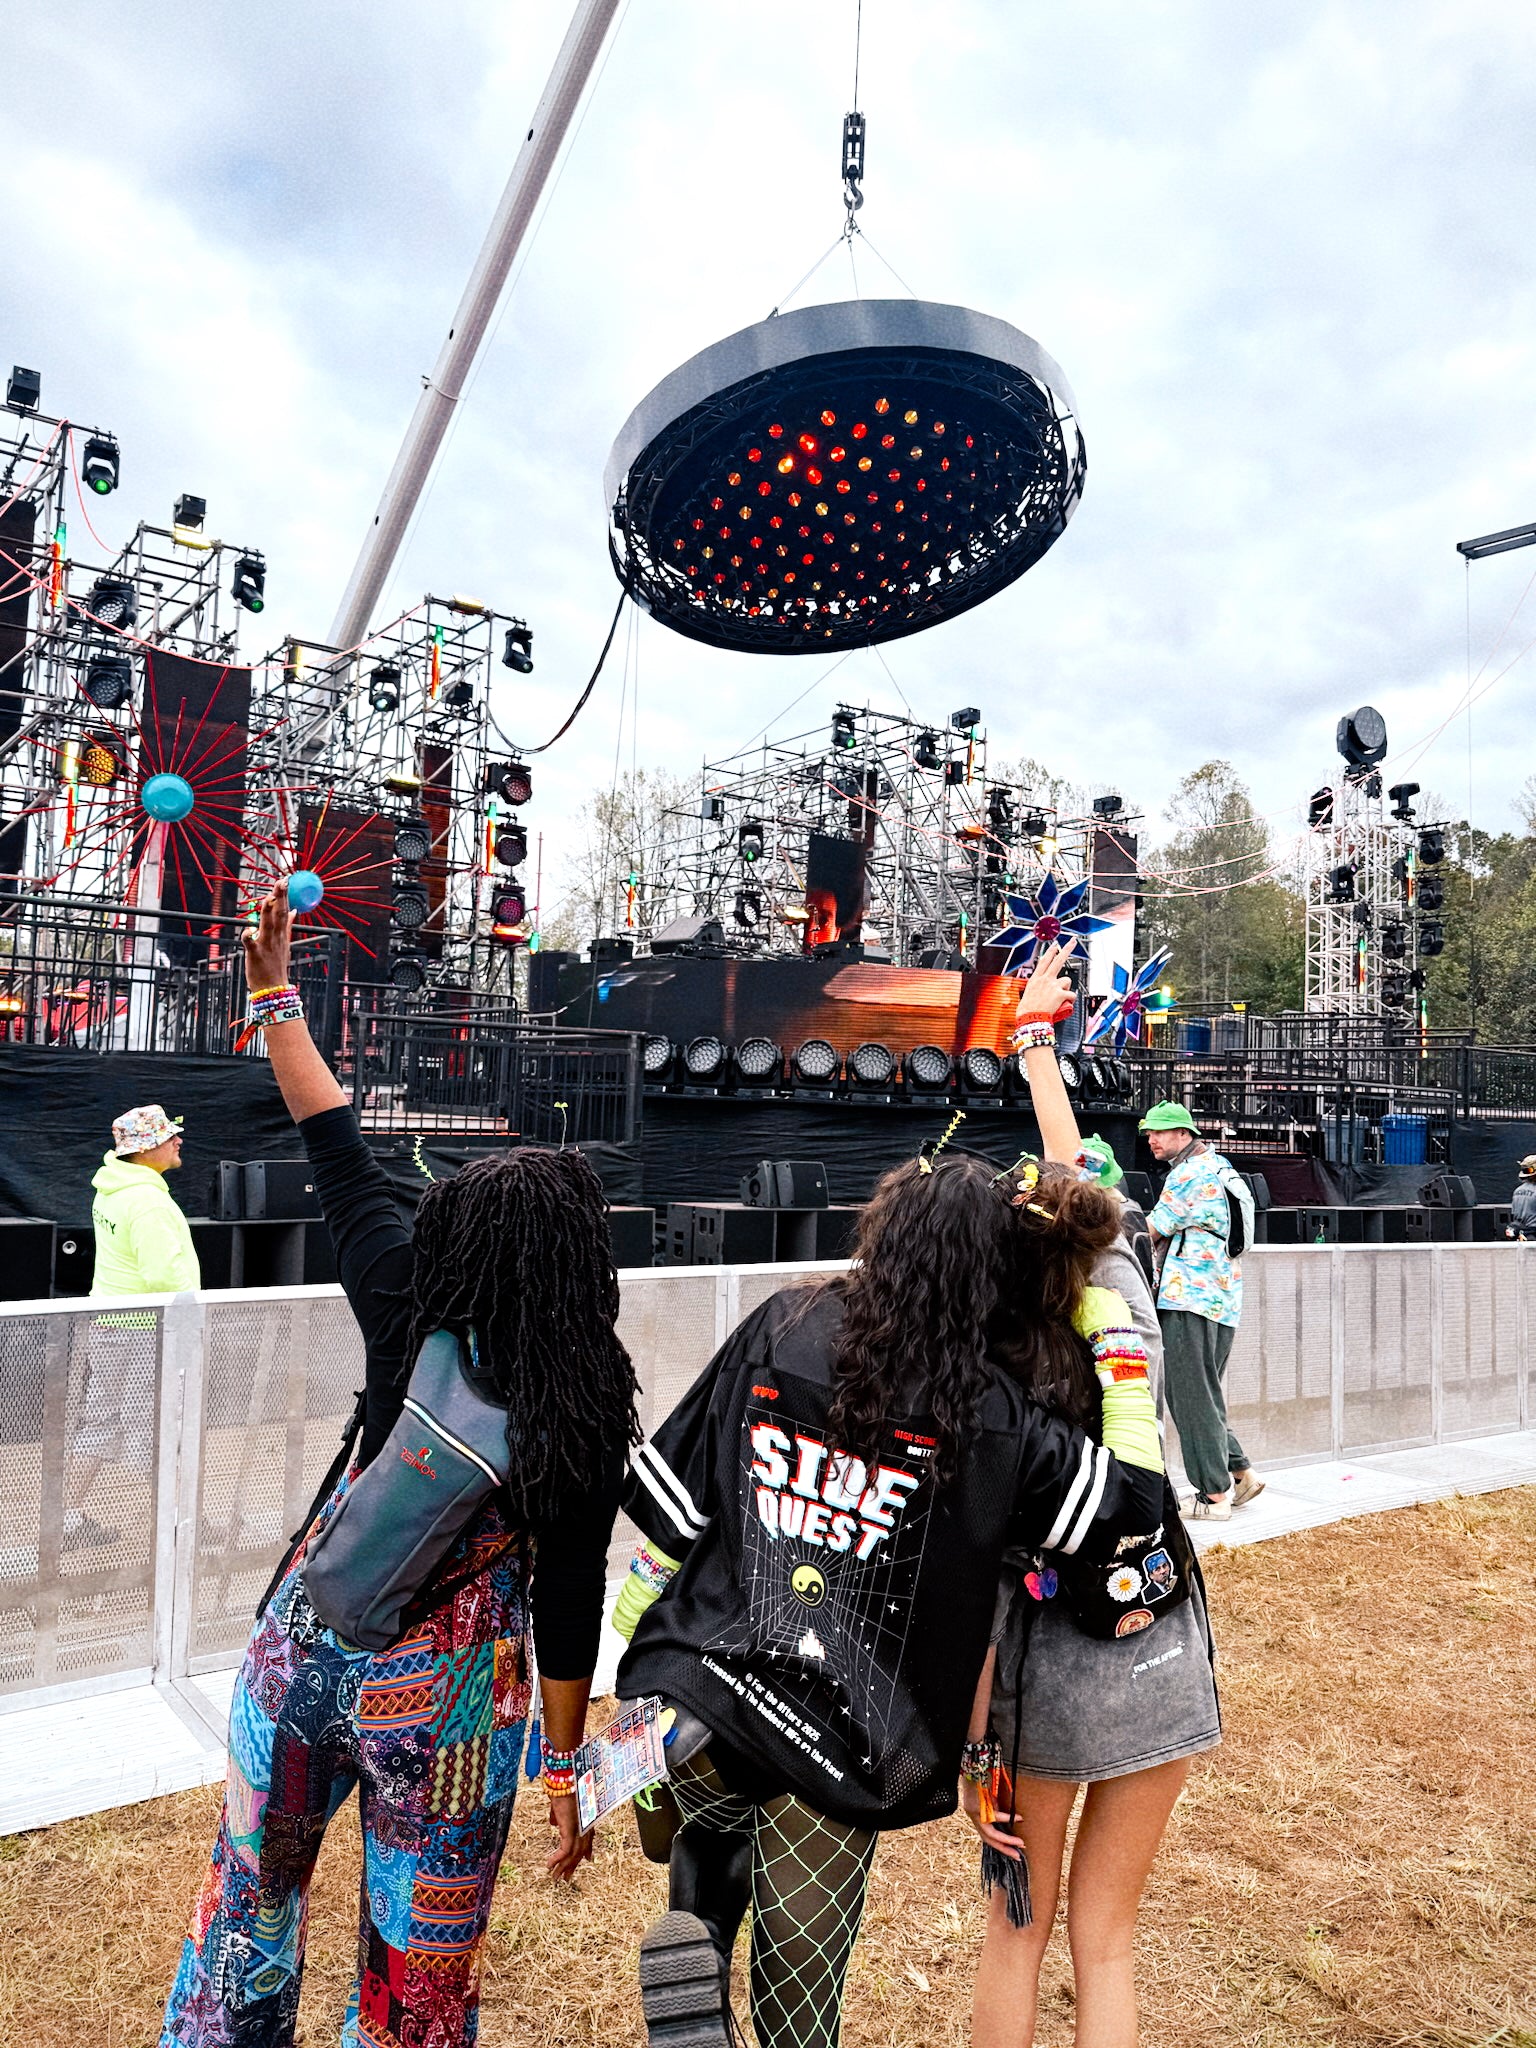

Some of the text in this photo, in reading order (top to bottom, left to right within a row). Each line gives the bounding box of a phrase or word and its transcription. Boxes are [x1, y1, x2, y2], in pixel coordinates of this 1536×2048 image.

[894, 1429, 937, 1446] HIGH SCORE
[751, 1421, 919, 1527] SIDE
[756, 1485, 889, 1560] QUEST
[1133, 1662, 1148, 1673] FOR
[1146, 1656, 1161, 1668] THE
[702, 1655, 737, 1686] Licensed
[734, 1681, 746, 1696] by
[745, 1689, 759, 1706] The
[757, 1702, 787, 1731] Baddest
[800, 1742, 811, 1753] on
[810, 1749, 824, 1763] the
[822, 1759, 844, 1781] Planet
[751, 1678, 765, 1693] For
[765, 1690, 778, 1705] the
[776, 1702, 802, 1727] Afters
[801, 1722, 821, 1741] 2025
